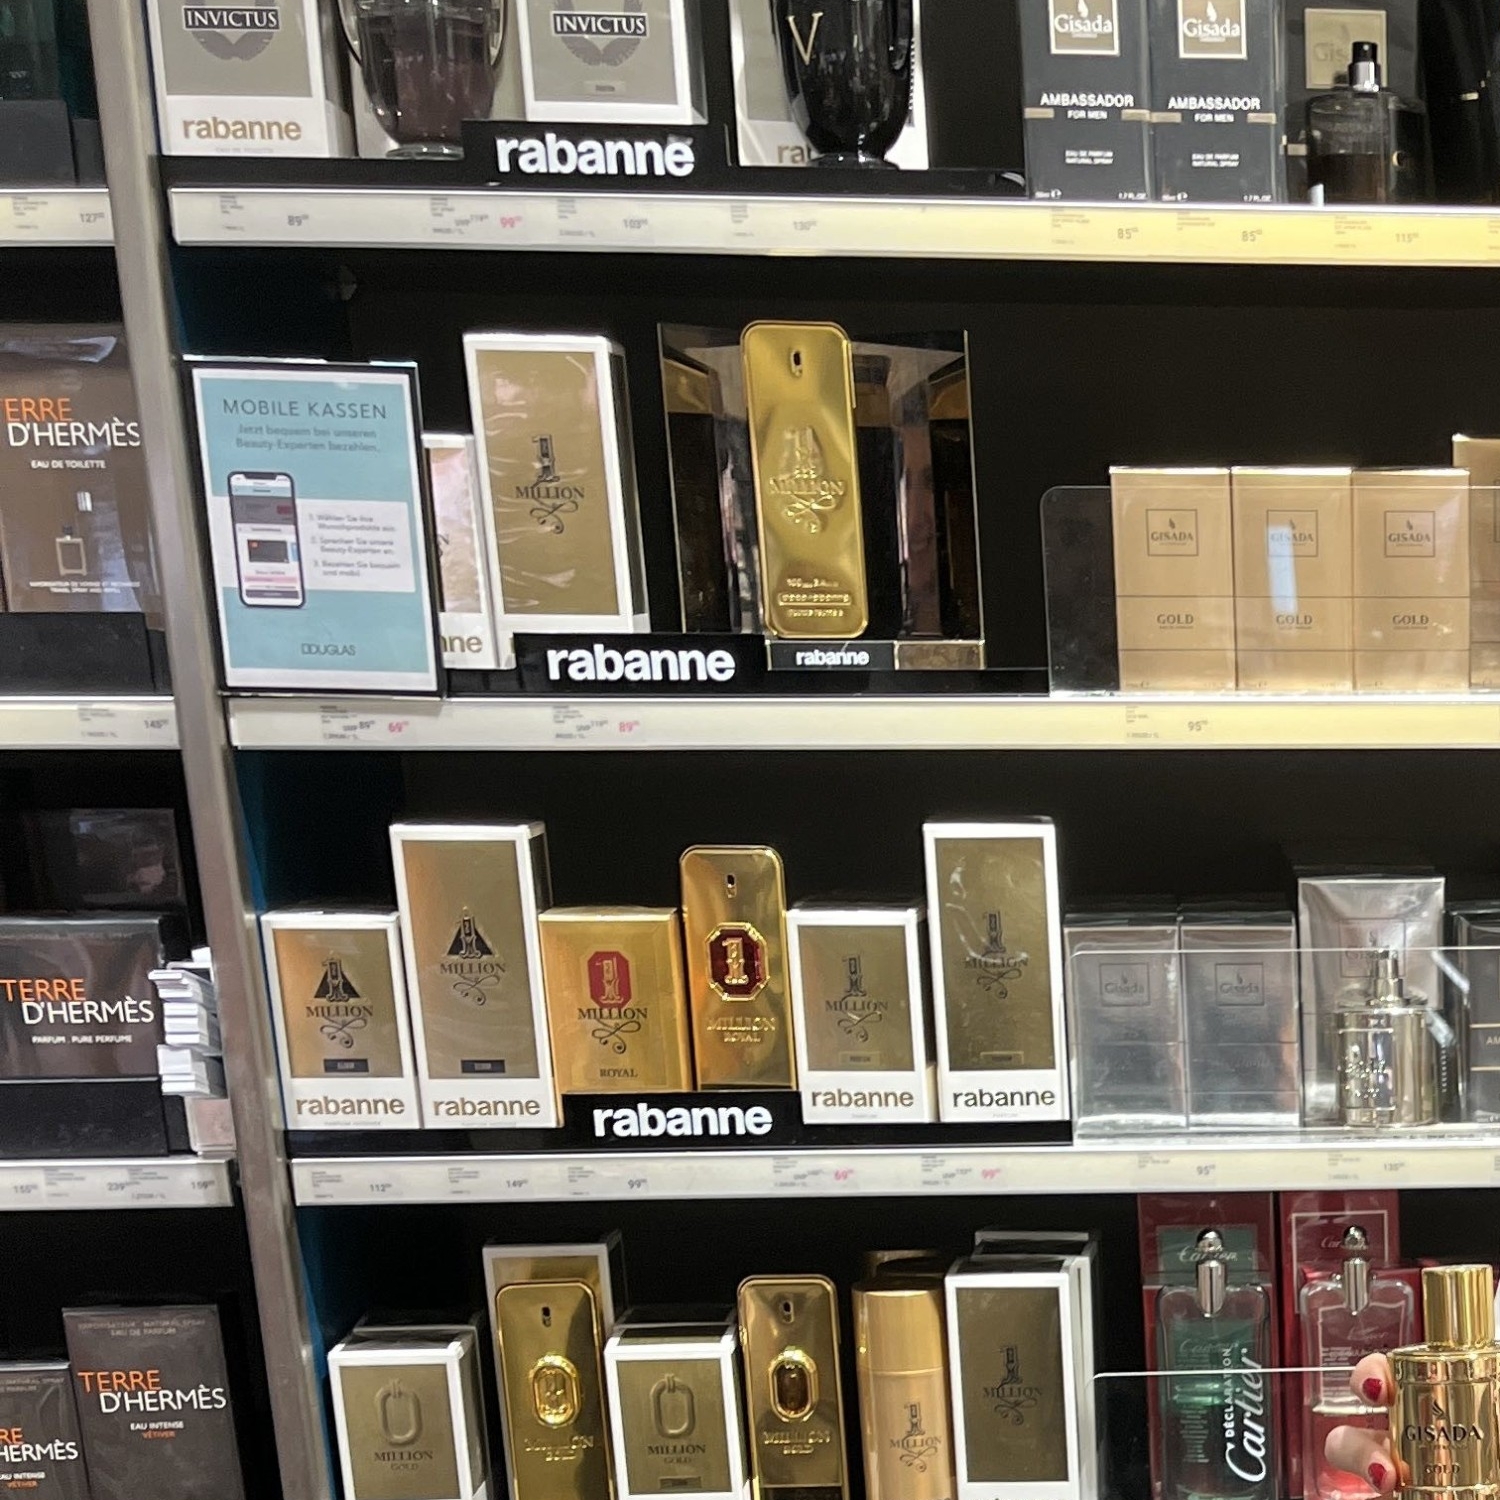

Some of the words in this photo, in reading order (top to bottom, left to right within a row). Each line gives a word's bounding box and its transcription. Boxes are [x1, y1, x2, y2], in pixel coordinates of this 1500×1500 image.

[186, 8, 278, 29] INVICTUS
[556, 14, 645, 35] INVICTUS
[1055, 14, 1112, 34] Gisada
[1183, 19, 1241, 38] Gisada
[787, 12, 823, 65] V
[1040, 93, 1134, 107] AMBASSADOR
[1168, 96, 1261, 111] AMBASSADOR
[182, 117, 301, 141] rabanne
[496, 133, 695, 177] rabanne
[0, 397, 74, 422] ERRE
[223, 399, 299, 416] MOBILE
[308, 402, 387, 419] KASSEN
[8, 417, 141, 447] D'HERMÈS
[515, 484, 585, 501] MILLION
[769, 477, 845, 497] MILLION
[1150, 531, 1194, 543] GISADA
[1270, 532, 1314, 544] GISADA
[1388, 532, 1431, 543] GISADA
[1156, 614, 1194, 625] GOLD
[1276, 614, 1313, 626] GOLD
[1392, 614, 1429, 626] GOLD
[301, 643, 356, 656] DOUGLAS
[547, 643, 735, 683] rabanne
[796, 650, 869, 666] rabanne
[440, 961, 506, 975] MILLION
[964, 955, 1028, 970] MILLION
[0, 978, 87, 1002] TERRE
[1104, 981, 1145, 996] Gisada
[1219, 981, 1261, 996] Gisada
[22, 995, 155, 1025] D'HERMÈS
[306, 1004, 374, 1018] MILLION
[578, 1006, 648, 1021] MILLION
[826, 999, 888, 1012] MILLION
[706, 1015, 776, 1031] MILLION
[600, 1068, 639, 1079] ROYAL
[296, 1096, 405, 1116] rabanne
[812, 1088, 914, 1108] rabanne
[953, 1088, 1055, 1108] rabanne
[433, 1097, 541, 1117] rabanne
[593, 1103, 773, 1138] rabanne
[77, 1370, 162, 1393] TERRE
[100, 1384, 227, 1413] D'HERMÈS
[983, 1386, 1043, 1399] MILLION
[1222, 1347, 1236, 1438] DÉCLARATION
[1225, 1347, 1267, 1482] Cartier
[149, 1421, 184, 1430] INTENSE
[1403, 1424, 1482, 1442] GISADA
[763, 1431, 832, 1446] MILLION
[890, 1436, 942, 1449] MILLION
[374, 1451, 433, 1462] MILLION
[648, 1444, 706, 1455] MILLION
[390, 1462, 419, 1471] GOLD
[664, 1457, 692, 1466] GOLD
[1424, 1463, 1460, 1475] GOLD
